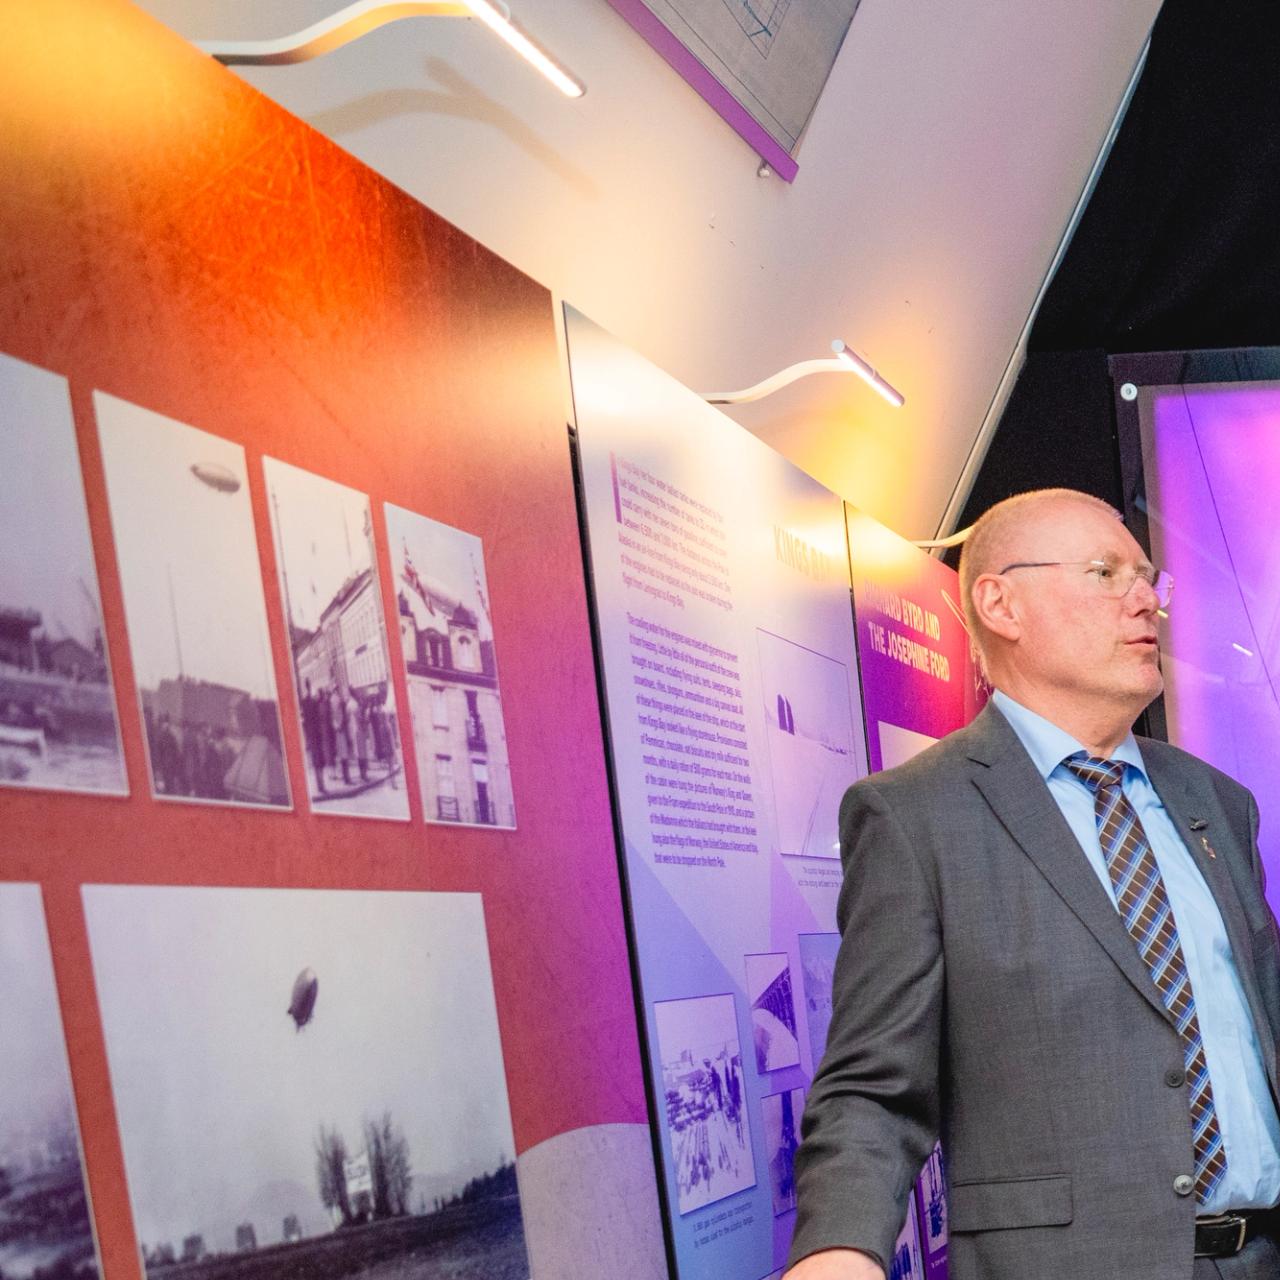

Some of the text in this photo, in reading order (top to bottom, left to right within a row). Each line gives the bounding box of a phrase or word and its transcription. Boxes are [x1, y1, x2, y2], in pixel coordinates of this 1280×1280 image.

[901, 597, 924, 634] BYRD
[924, 609, 941, 641] AND
[868, 620, 951, 683] THE JOSEPHINE FORD
